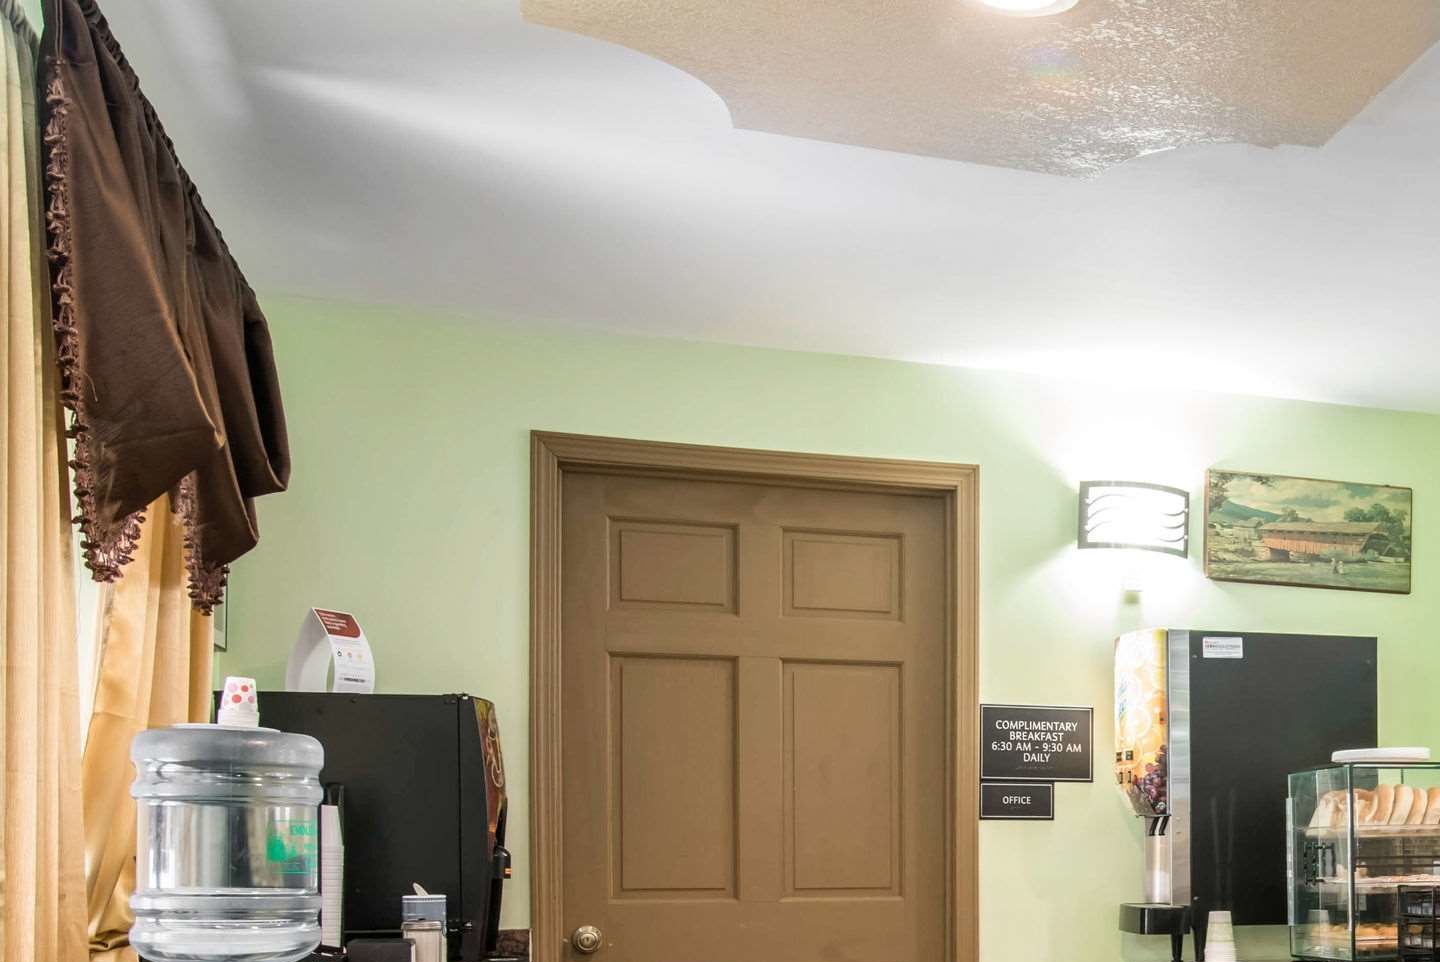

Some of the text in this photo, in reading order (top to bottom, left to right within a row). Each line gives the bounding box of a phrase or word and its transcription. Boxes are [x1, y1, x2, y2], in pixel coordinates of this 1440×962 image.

[995, 720, 1078, 732] COMPLIMENTARY
[1009, 731, 1064, 742] BREAKFAST
[991, 742, 1012, 751] 6:30
[1015, 743, 1032, 751] AM
[1042, 743, 1063, 753] 9:30
[1066, 744, 1082, 753] AM
[1023, 753, 1051, 763] DAILY
[1002, 796, 1032, 805] OFFICE
